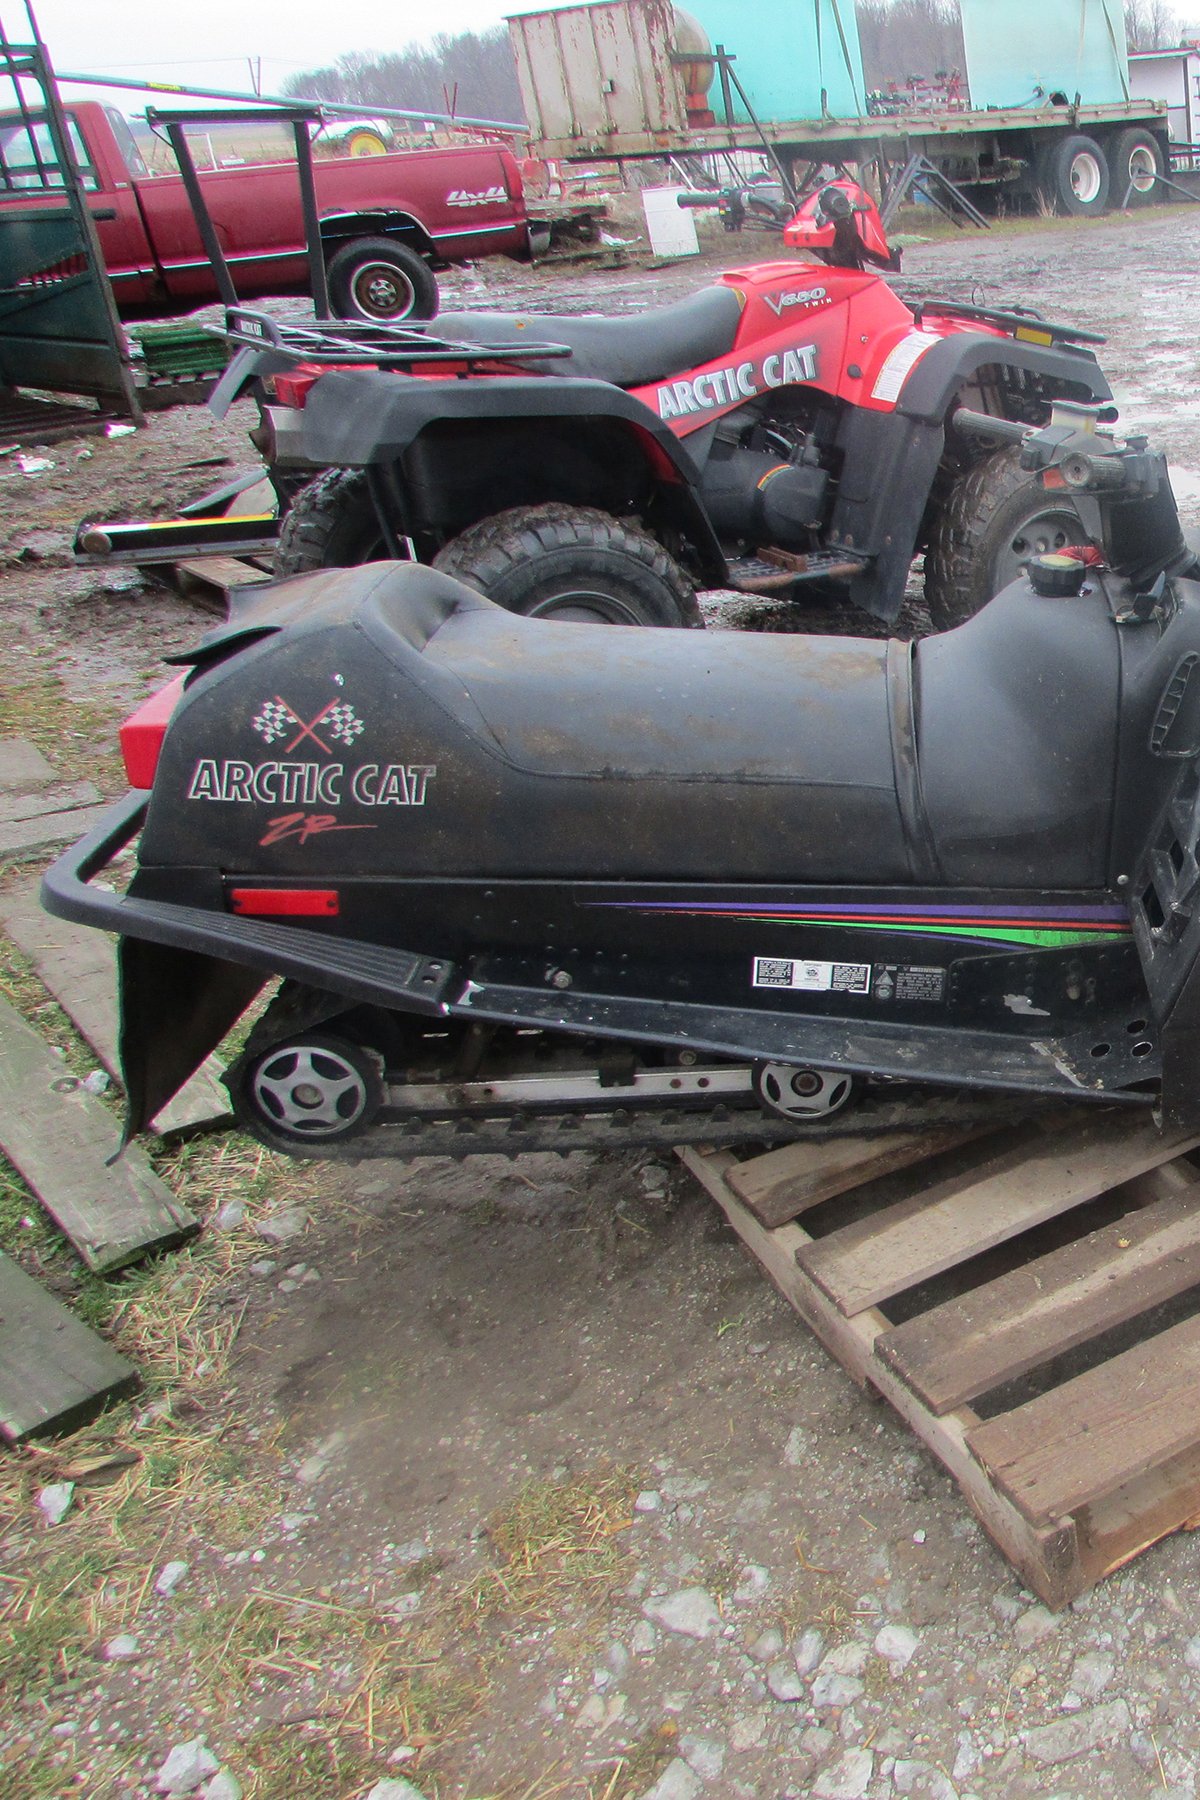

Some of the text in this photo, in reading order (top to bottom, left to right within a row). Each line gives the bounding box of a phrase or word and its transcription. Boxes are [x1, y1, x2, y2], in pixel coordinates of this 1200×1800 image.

[446, 186, 508, 207] 4x4
[804, 297, 832, 309] TWIN
[657, 362, 758, 419] ARCTIC
[762, 345, 817, 388] CAT
[188, 760, 437, 806] ARCTIC CAT
[259, 812, 377, 846] ZR
